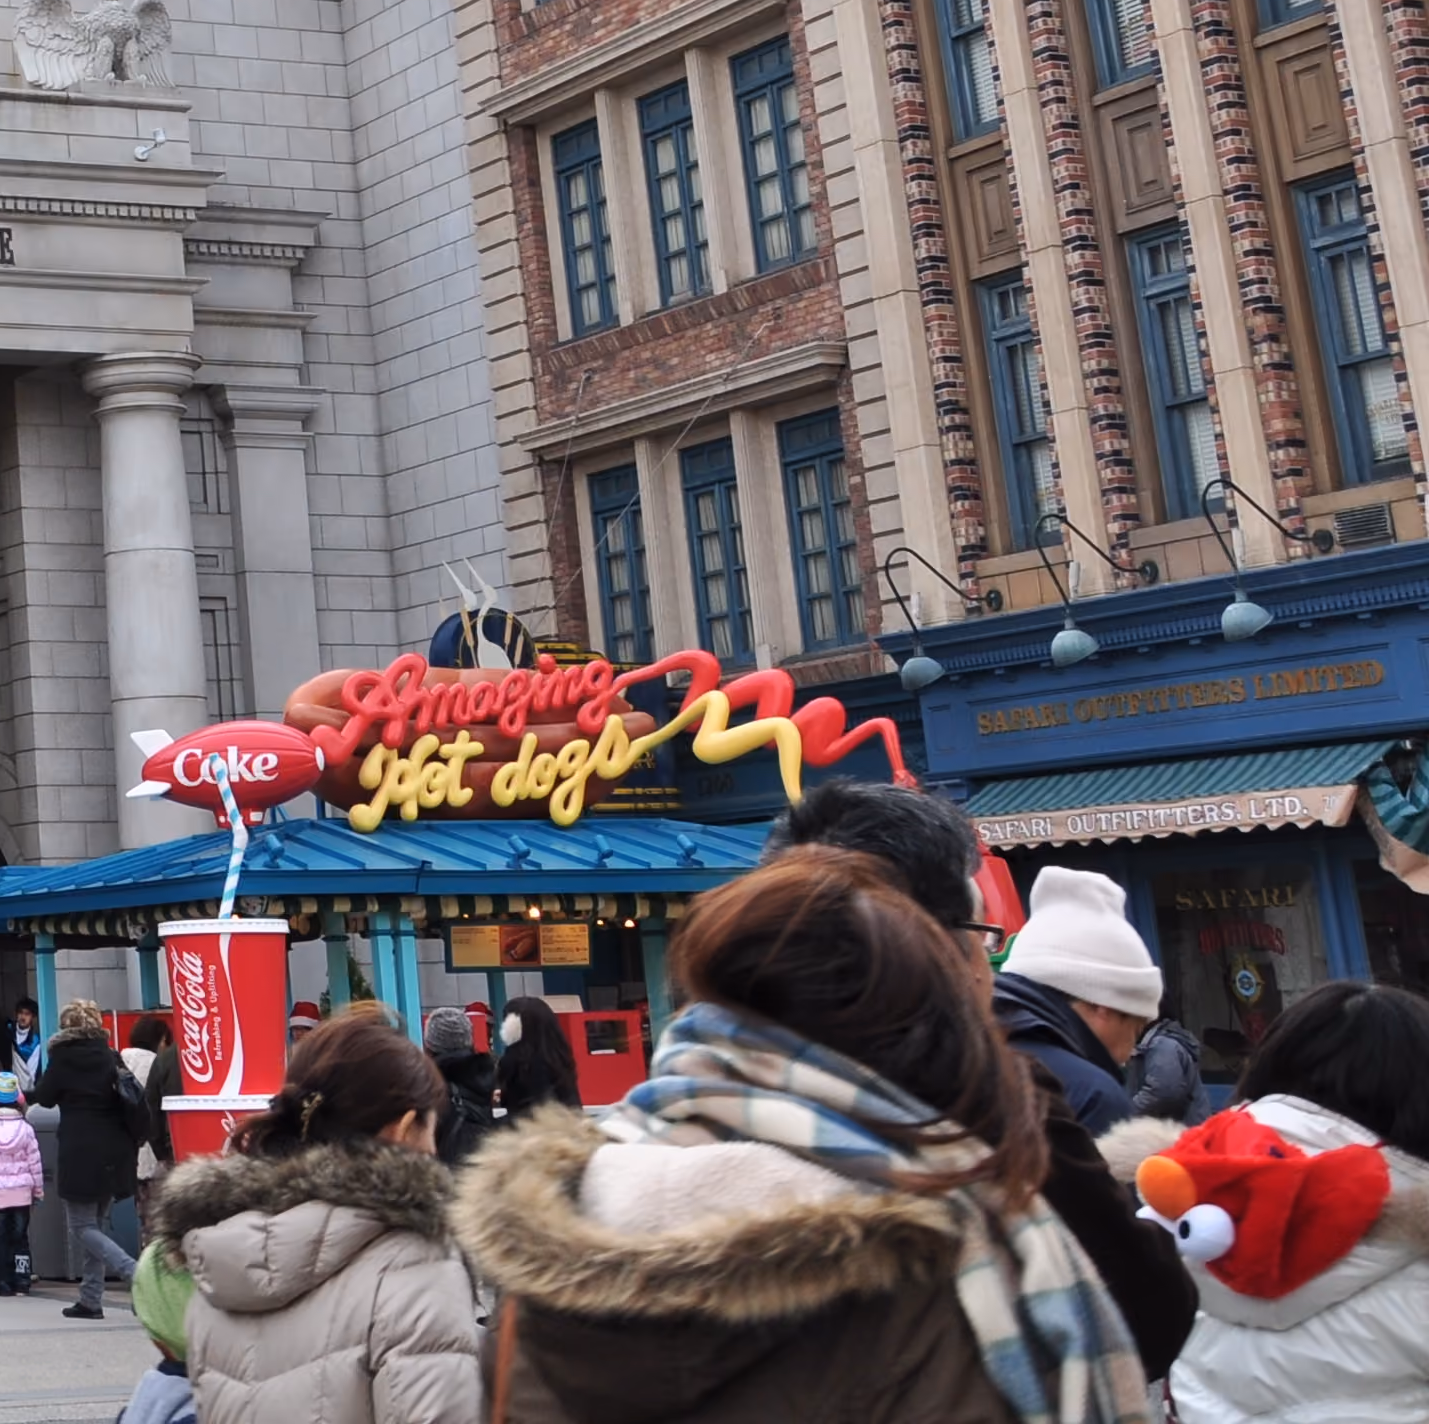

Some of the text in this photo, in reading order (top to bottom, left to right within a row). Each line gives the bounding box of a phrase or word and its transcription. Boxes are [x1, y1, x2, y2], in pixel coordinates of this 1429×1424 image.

[309, 652, 616, 766] Amazing
[977, 659, 1385, 736] SAFARI OUTFITTERS LIMITED
[173, 746, 279, 787] Coke
[348, 714, 633, 833] Hot dogs
[978, 817, 1053, 842] SAFARI
[1249, 795, 1309, 819] LTD.
[1176, 886, 1296, 910] SAFARI
[207, 964, 219, 1004] Uplifting
[214, 1016, 223, 1061] Refreshing
